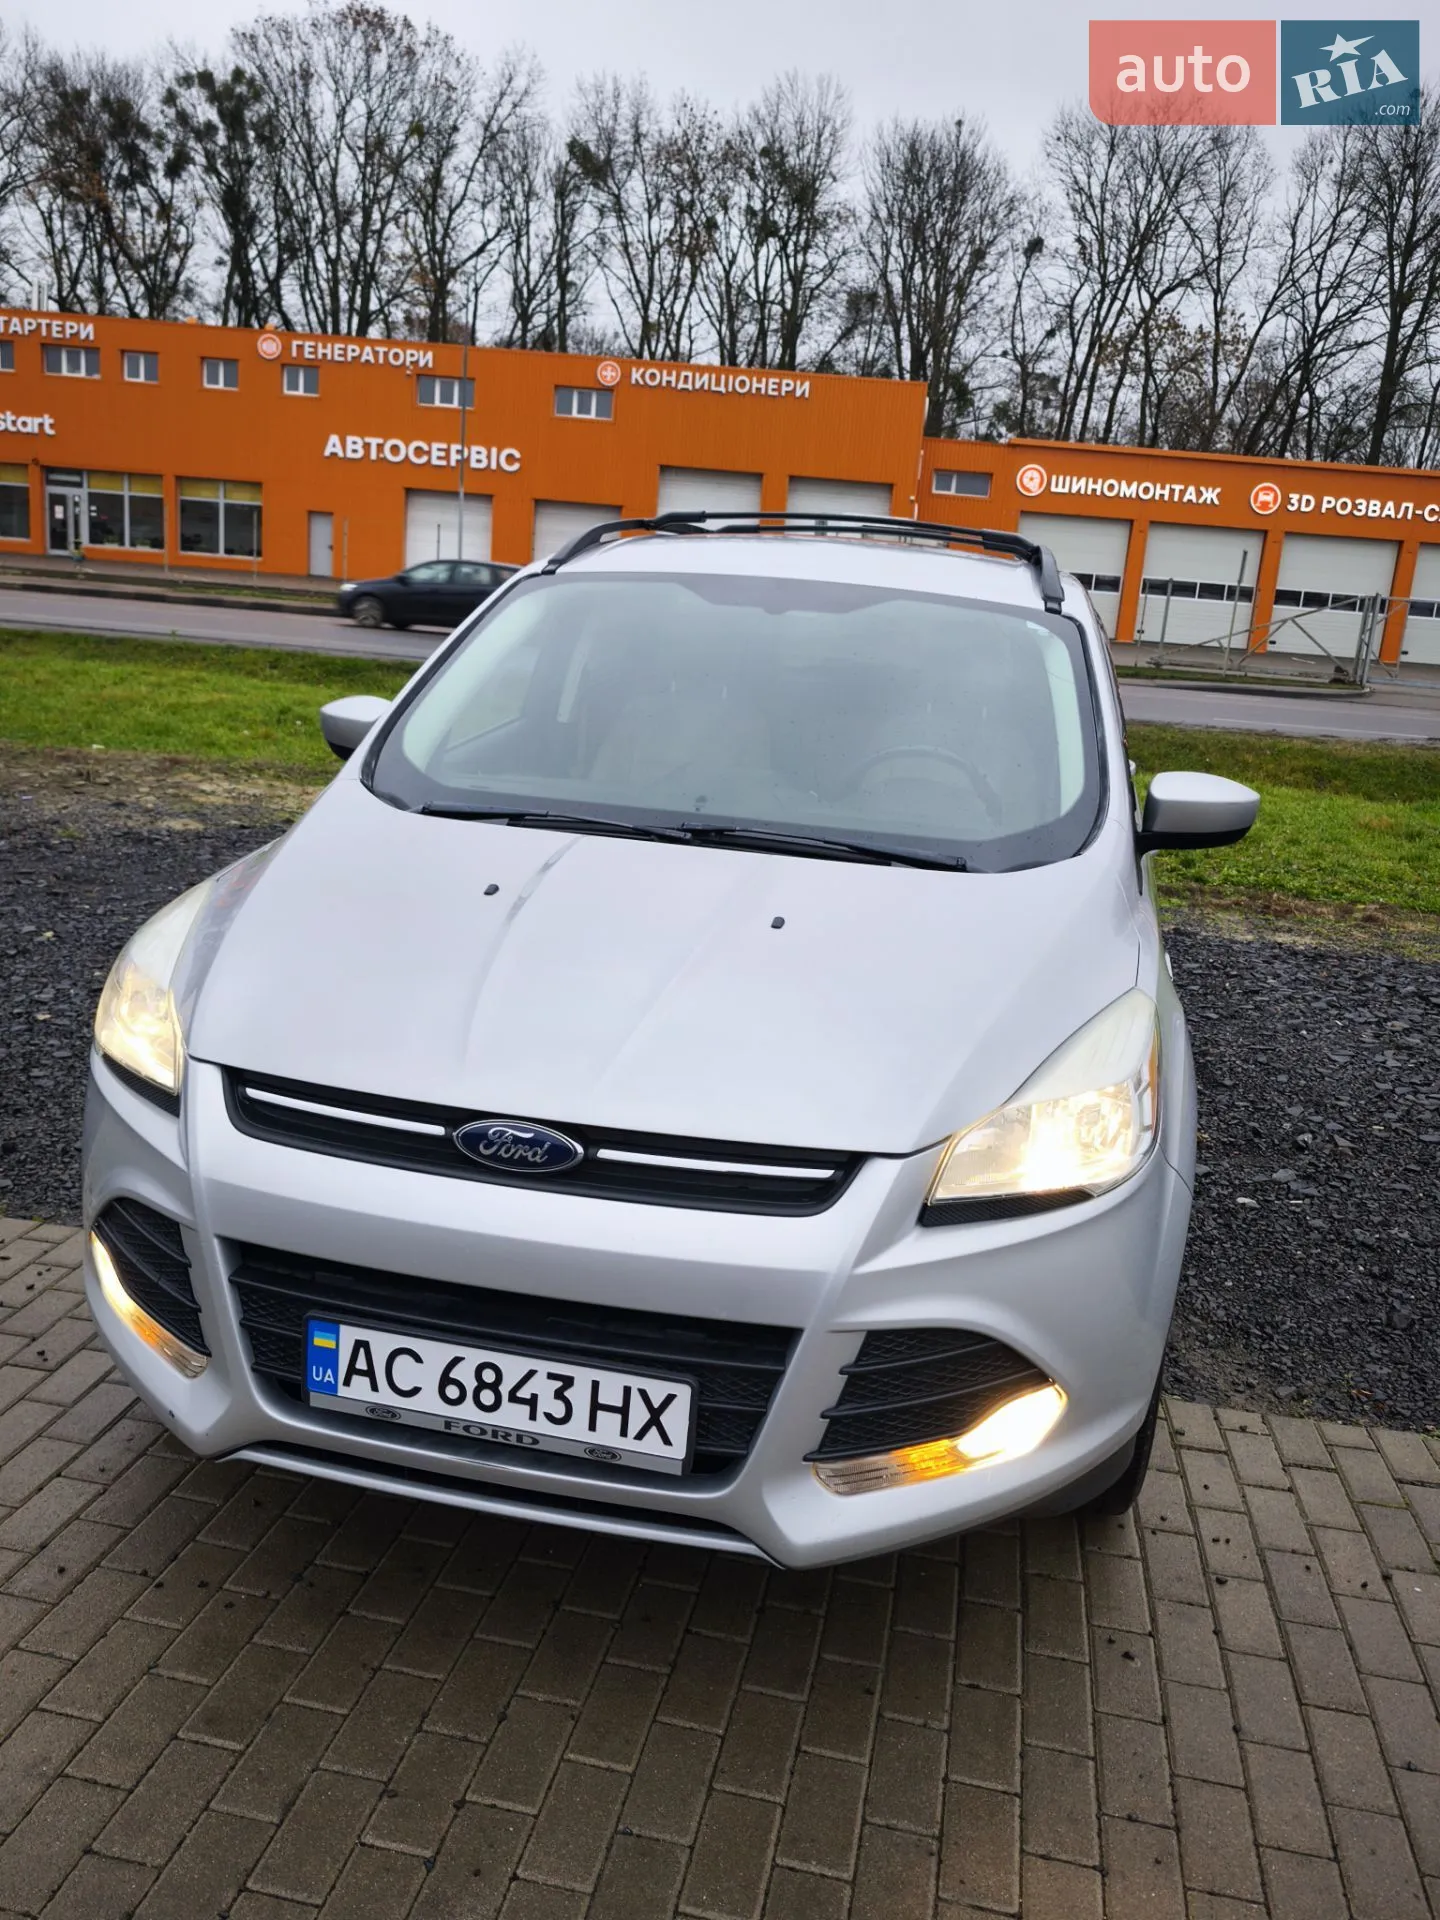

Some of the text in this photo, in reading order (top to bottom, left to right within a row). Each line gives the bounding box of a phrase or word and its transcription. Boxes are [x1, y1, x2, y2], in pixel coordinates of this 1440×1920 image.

[290, 340, 434, 369] ГЕНЕРАТОРИ
[631, 367, 810, 398] КОНДИЦІОНЕРИ
[323, 433, 522, 473] АВТОСЕРВІС
[1049, 474, 1222, 505] ШИНОМОНТАЖ
[1286, 493, 1440, 523] 3D РОЗВАЛ-С
[478, 1126, 552, 1163] Ford
[312, 1366, 335, 1384] UA
[342, 1339, 678, 1447] AC 6843 HX
[443, 1419, 540, 1447] FORD
